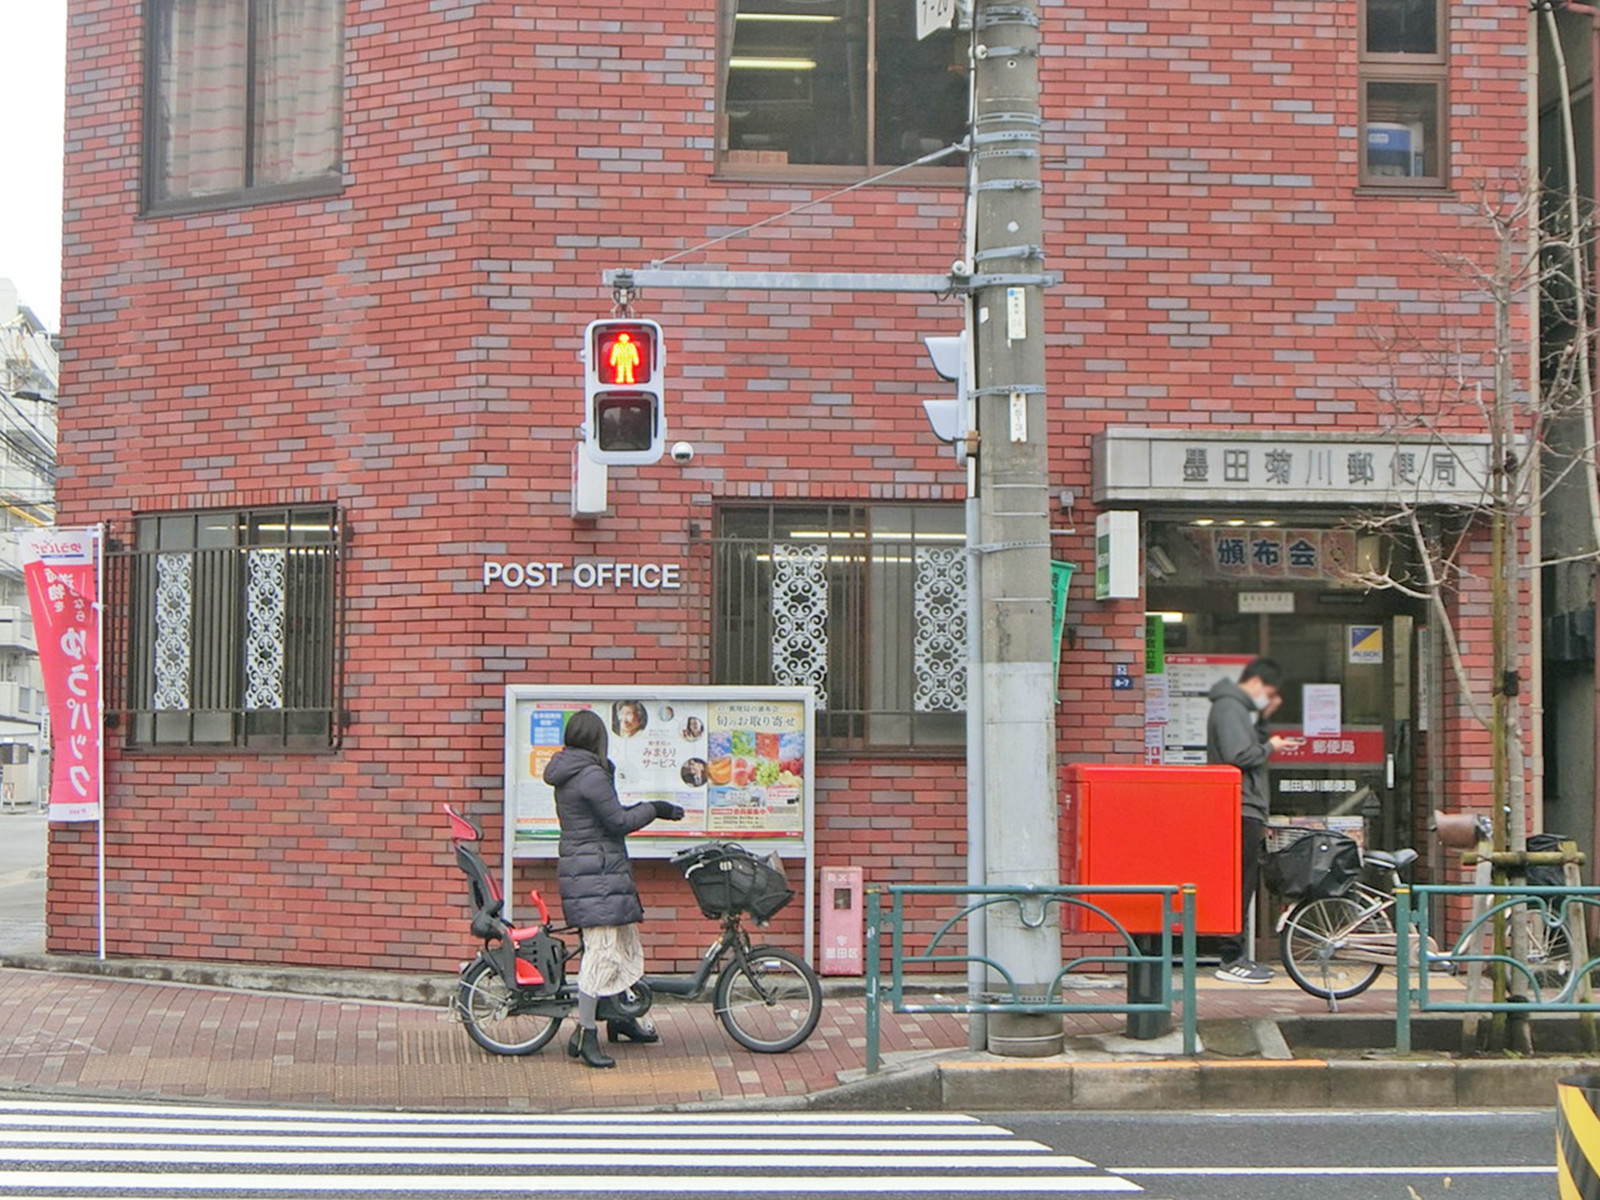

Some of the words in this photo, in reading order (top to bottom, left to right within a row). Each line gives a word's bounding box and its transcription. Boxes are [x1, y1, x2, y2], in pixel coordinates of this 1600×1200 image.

[1183, 447, 1458, 488] 墨田菊川郵便局
[1217, 538, 1318, 567] 頒布会
[483, 561, 563, 587] POST
[573, 563, 681, 588] OFFICE
[716, 714, 796, 727] 旬のお取り寄せ
[643, 747, 676, 758] みまもり
[1312, 739, 1355, 754] 郵便局
[642, 758, 677, 769] サービス
